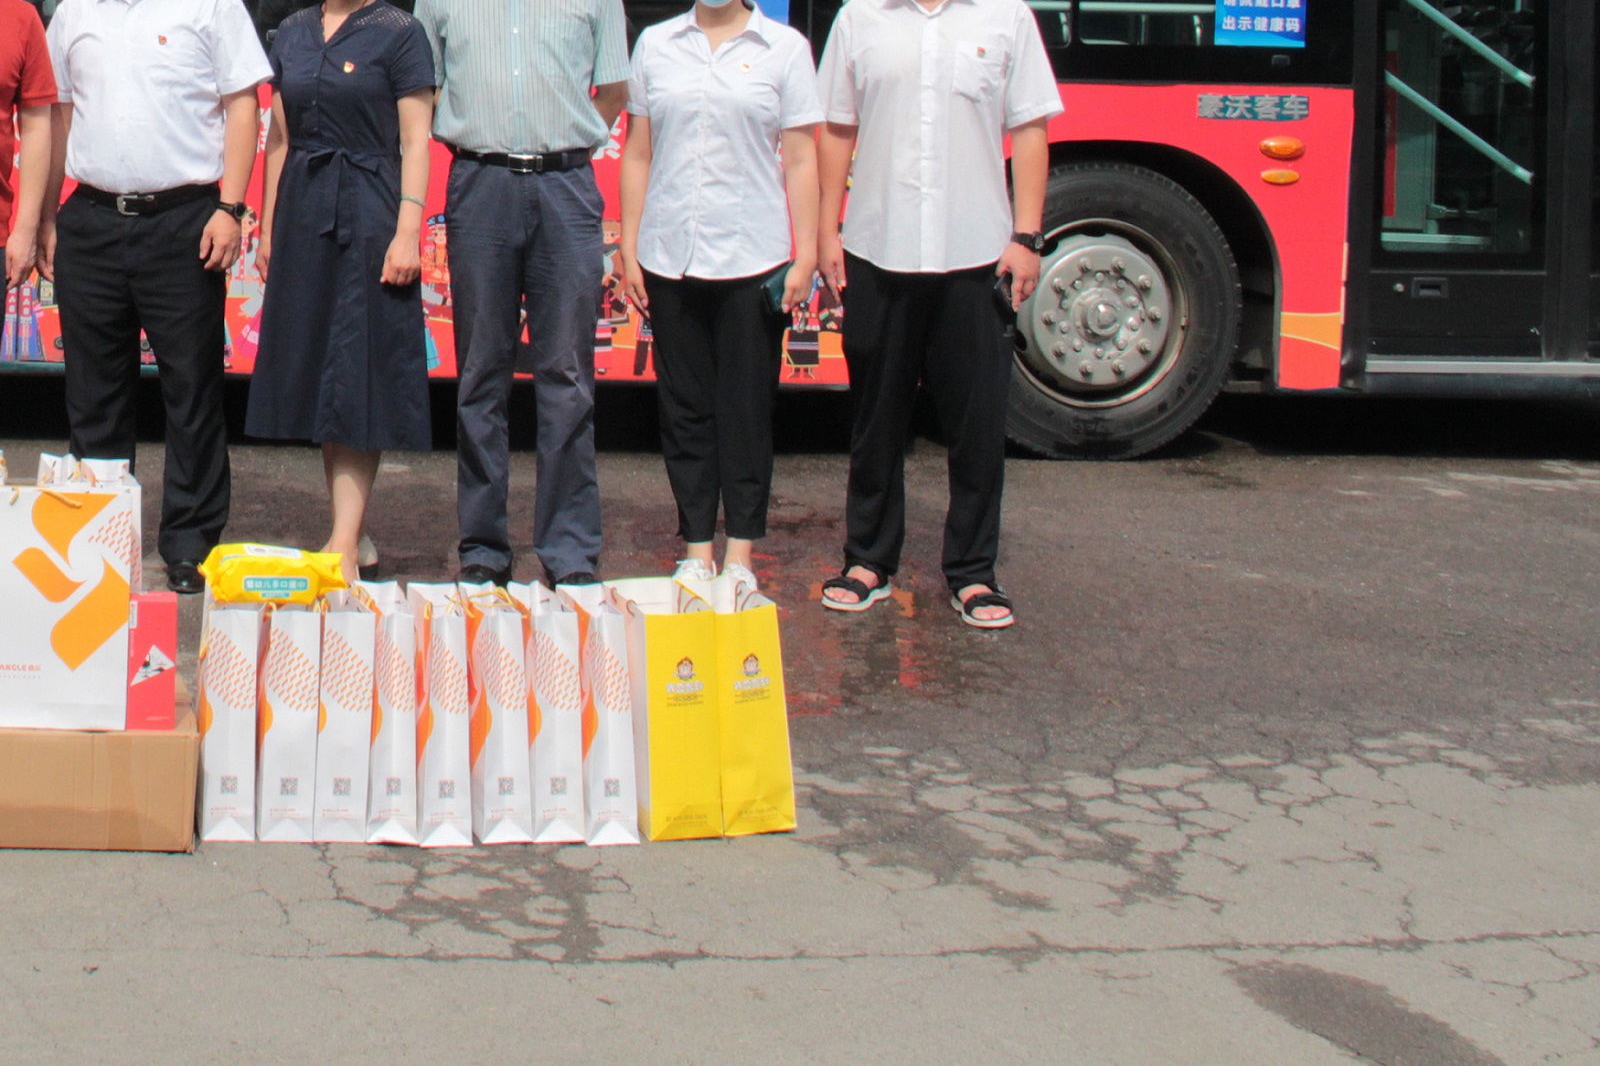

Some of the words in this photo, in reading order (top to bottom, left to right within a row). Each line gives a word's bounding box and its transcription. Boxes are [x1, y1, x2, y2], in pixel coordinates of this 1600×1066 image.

[1221, 14, 1301, 33] 出示健康码
[1198, 93, 1309, 121] 豪沃客车
